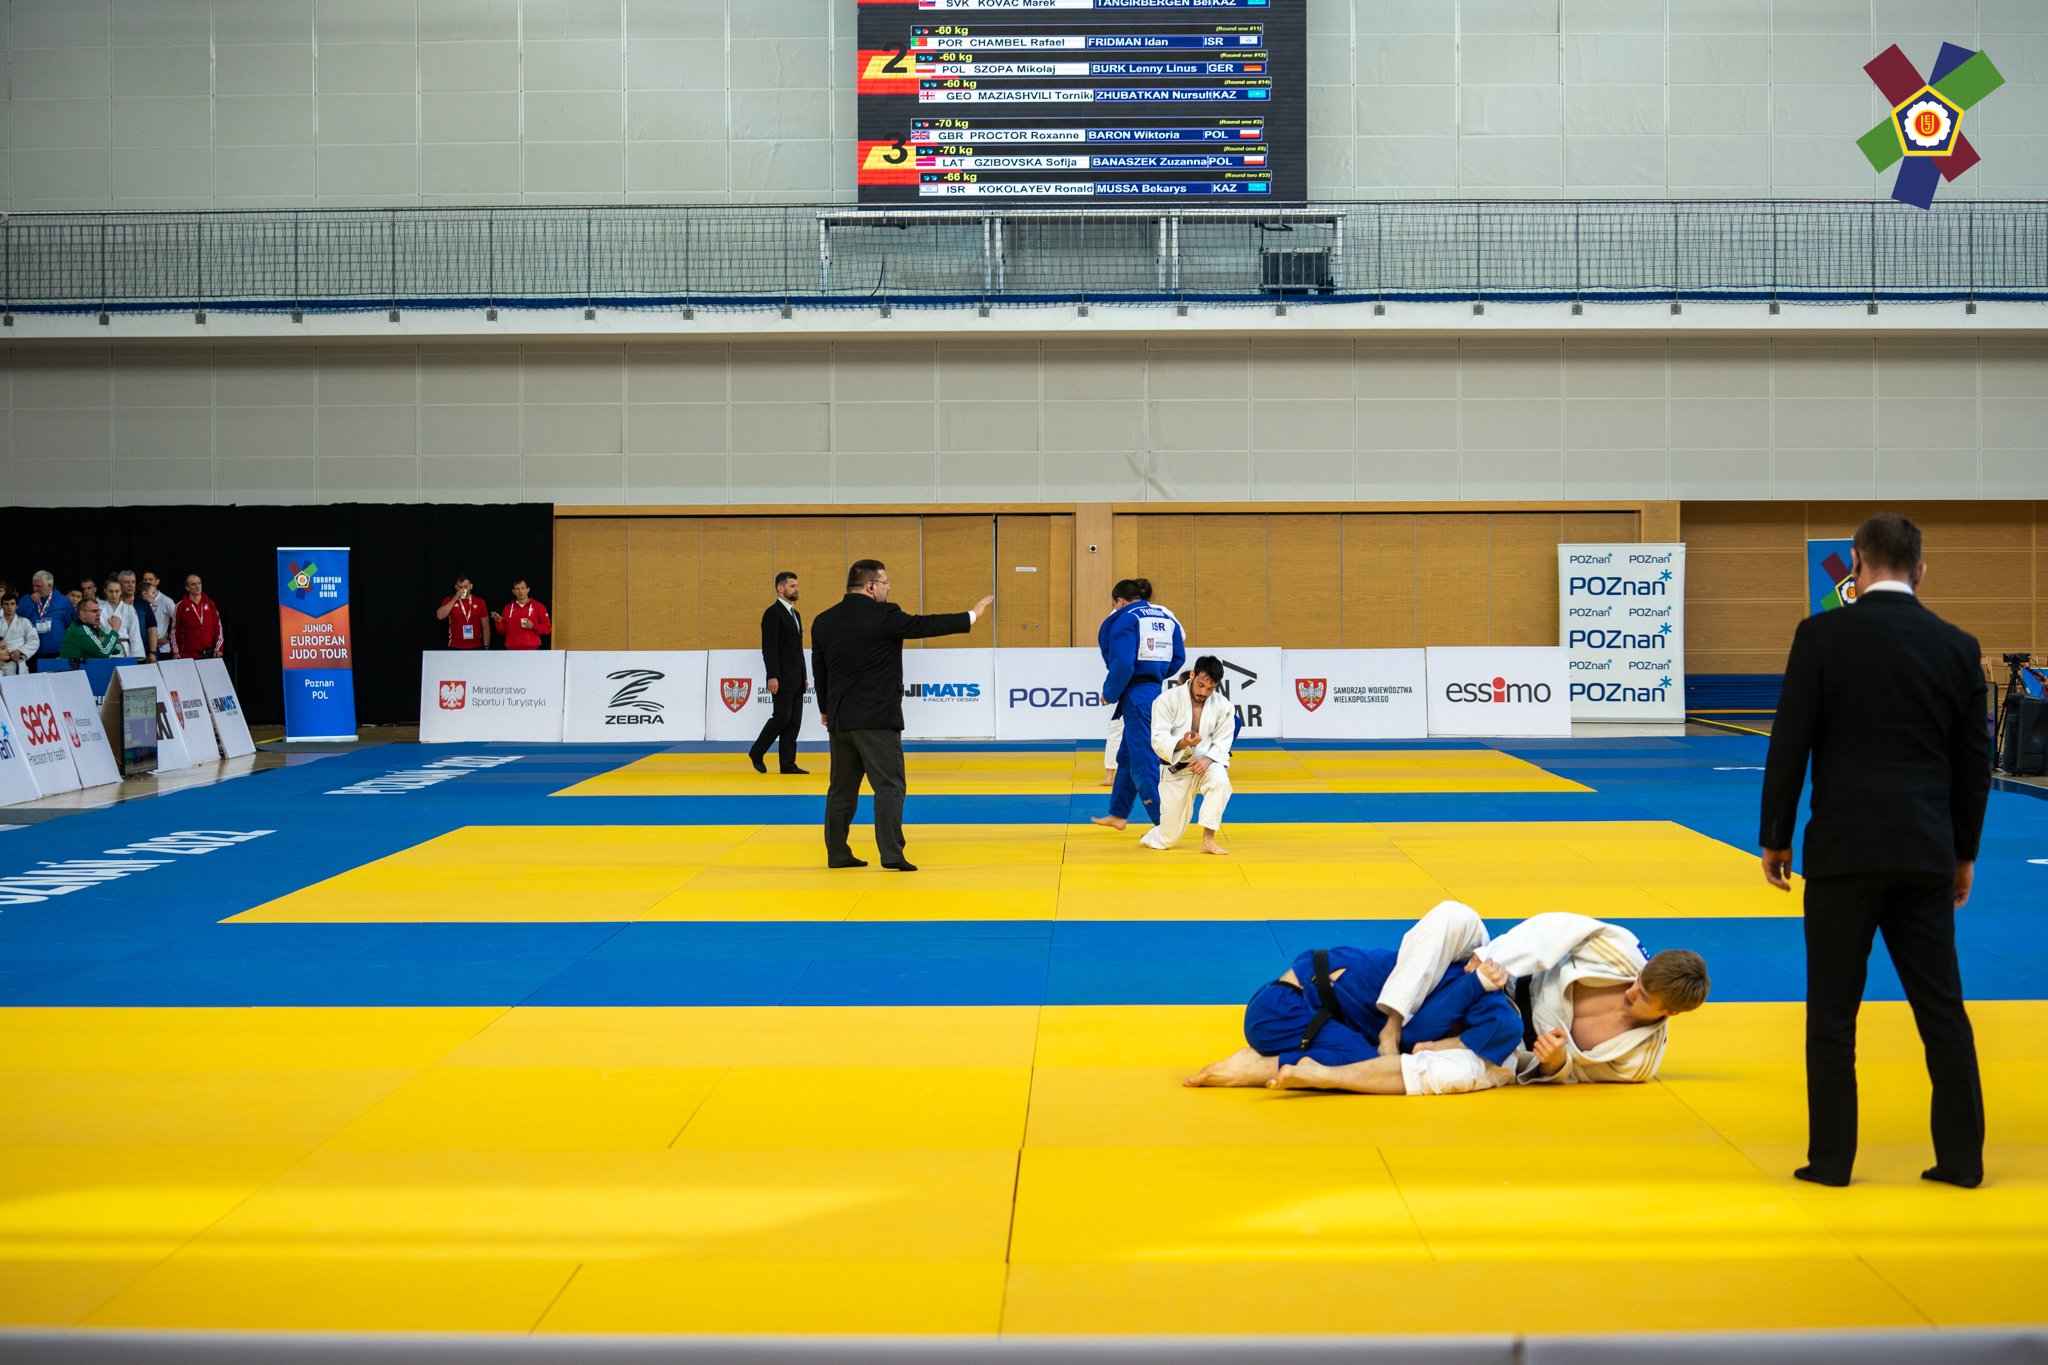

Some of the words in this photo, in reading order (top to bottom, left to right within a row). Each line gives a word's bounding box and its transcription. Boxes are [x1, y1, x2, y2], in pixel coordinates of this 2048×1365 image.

[954, 26, 968, 35] kg
[1030, 38, 1064, 46] Rafael
[882, 42, 907, 73] 2
[958, 53, 972, 62] kg
[1017, 65, 1056, 74] Mikolaj
[1129, 64, 1163, 74] Lenny
[1209, 64, 1233, 72] GER
[963, 80, 977, 89] kg
[955, 119, 968, 128] kg
[1134, 131, 1180, 139] Wiktoria
[883, 132, 908, 164] 3
[959, 146, 973, 155] kg
[1046, 158, 1077, 168] Sofija
[963, 173, 977, 182] kg
[1142, 185, 1186, 194] Bekarys
[1213, 184, 1237, 192] KAZ
[302, 624, 333, 633] JUNIOR
[1152, 622, 1165, 631] ISR
[290, 635, 345, 646] EUROPEAN
[289, 650, 318, 660] JUDO
[320, 648, 348, 659] TOUR
[304, 679, 334, 688] Poznan
[472, 686, 526, 694] Ministerstwo
[1333, 686, 1366, 695] SAMORZĄD
[1368, 685, 1413, 694] WOJEWÓDZTWA
[1446, 677, 1551, 703] essimo
[312, 691, 328, 699] POL
[472, 698, 500, 707] Sportu
[507, 698, 546, 708] Turystyki
[20, 702, 61, 746] seca
[605, 715, 664, 725] ZEBRA
[103, 830, 278, 854] 2022
